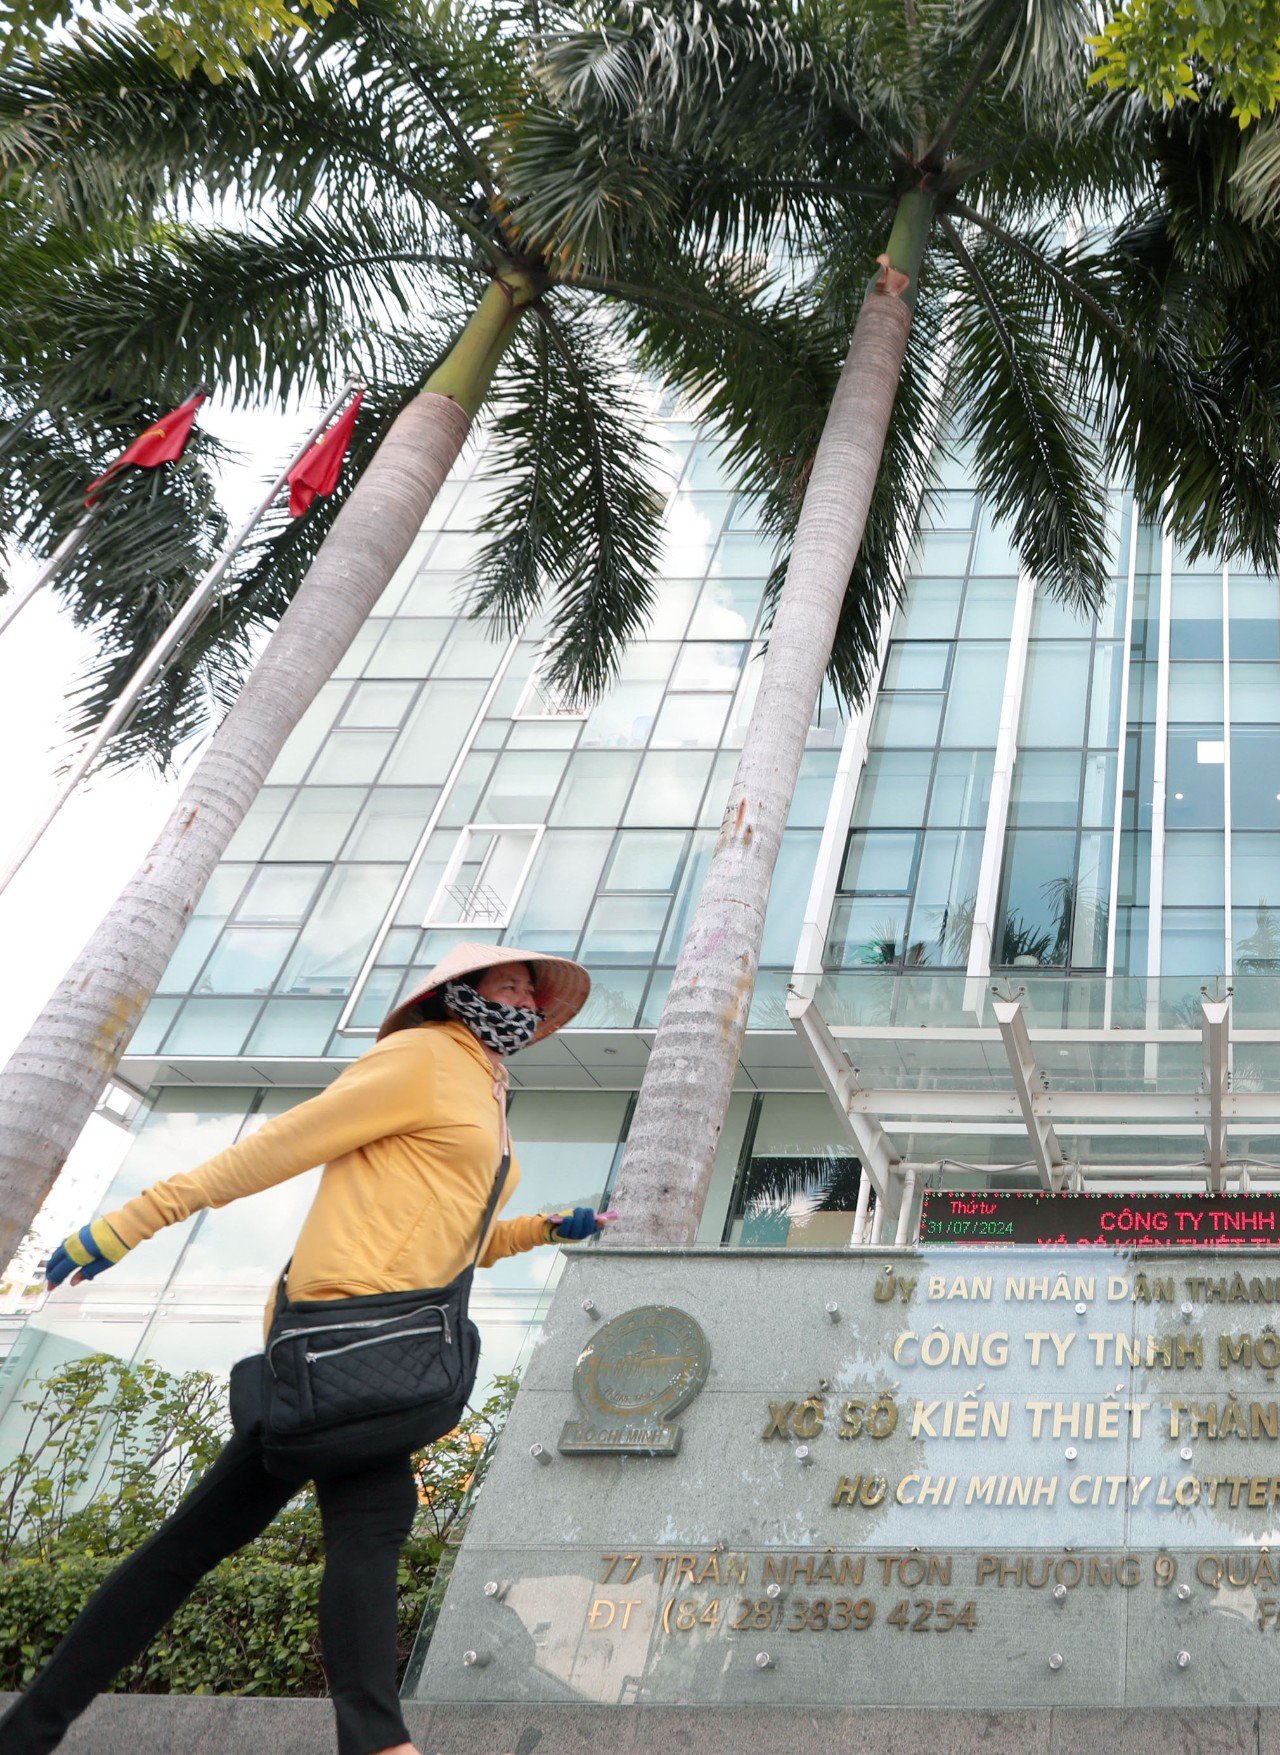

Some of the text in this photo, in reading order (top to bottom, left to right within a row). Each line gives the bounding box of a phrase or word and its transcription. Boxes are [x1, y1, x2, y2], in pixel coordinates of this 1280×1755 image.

[1100, 1208, 1168, 1231] CÔNG
[1175, 1211, 1204, 1231] TY
[1208, 1210, 1275, 1230] TNHH
[874, 1265, 918, 1303] ỦY
[928, 1275, 994, 1301] BAN
[1004, 1271, 1096, 1301] NHÂN
[1107, 1272, 1176, 1303] DÂN
[893, 1323, 1010, 1367] CÔNG
[1024, 1331, 1077, 1367] TY
[1088, 1331, 1203, 1369] TNHH
[761, 1378, 830, 1441] XỔ
[837, 1381, 900, 1440] SỐ
[911, 1383, 1010, 1439] KIẾN
[1025, 1383, 1150, 1440] THIẾT
[831, 1474, 890, 1509] HO
[895, 1473, 958, 1506] CHI
[964, 1475, 1058, 1507] MINH
[1068, 1474, 1154, 1507] CITY
[601, 1553, 643, 1585] 77
[877, 1546, 953, 1586] TÔN
[1153, 1554, 1177, 1587] 9
[887, 1599, 978, 1633] 4254
